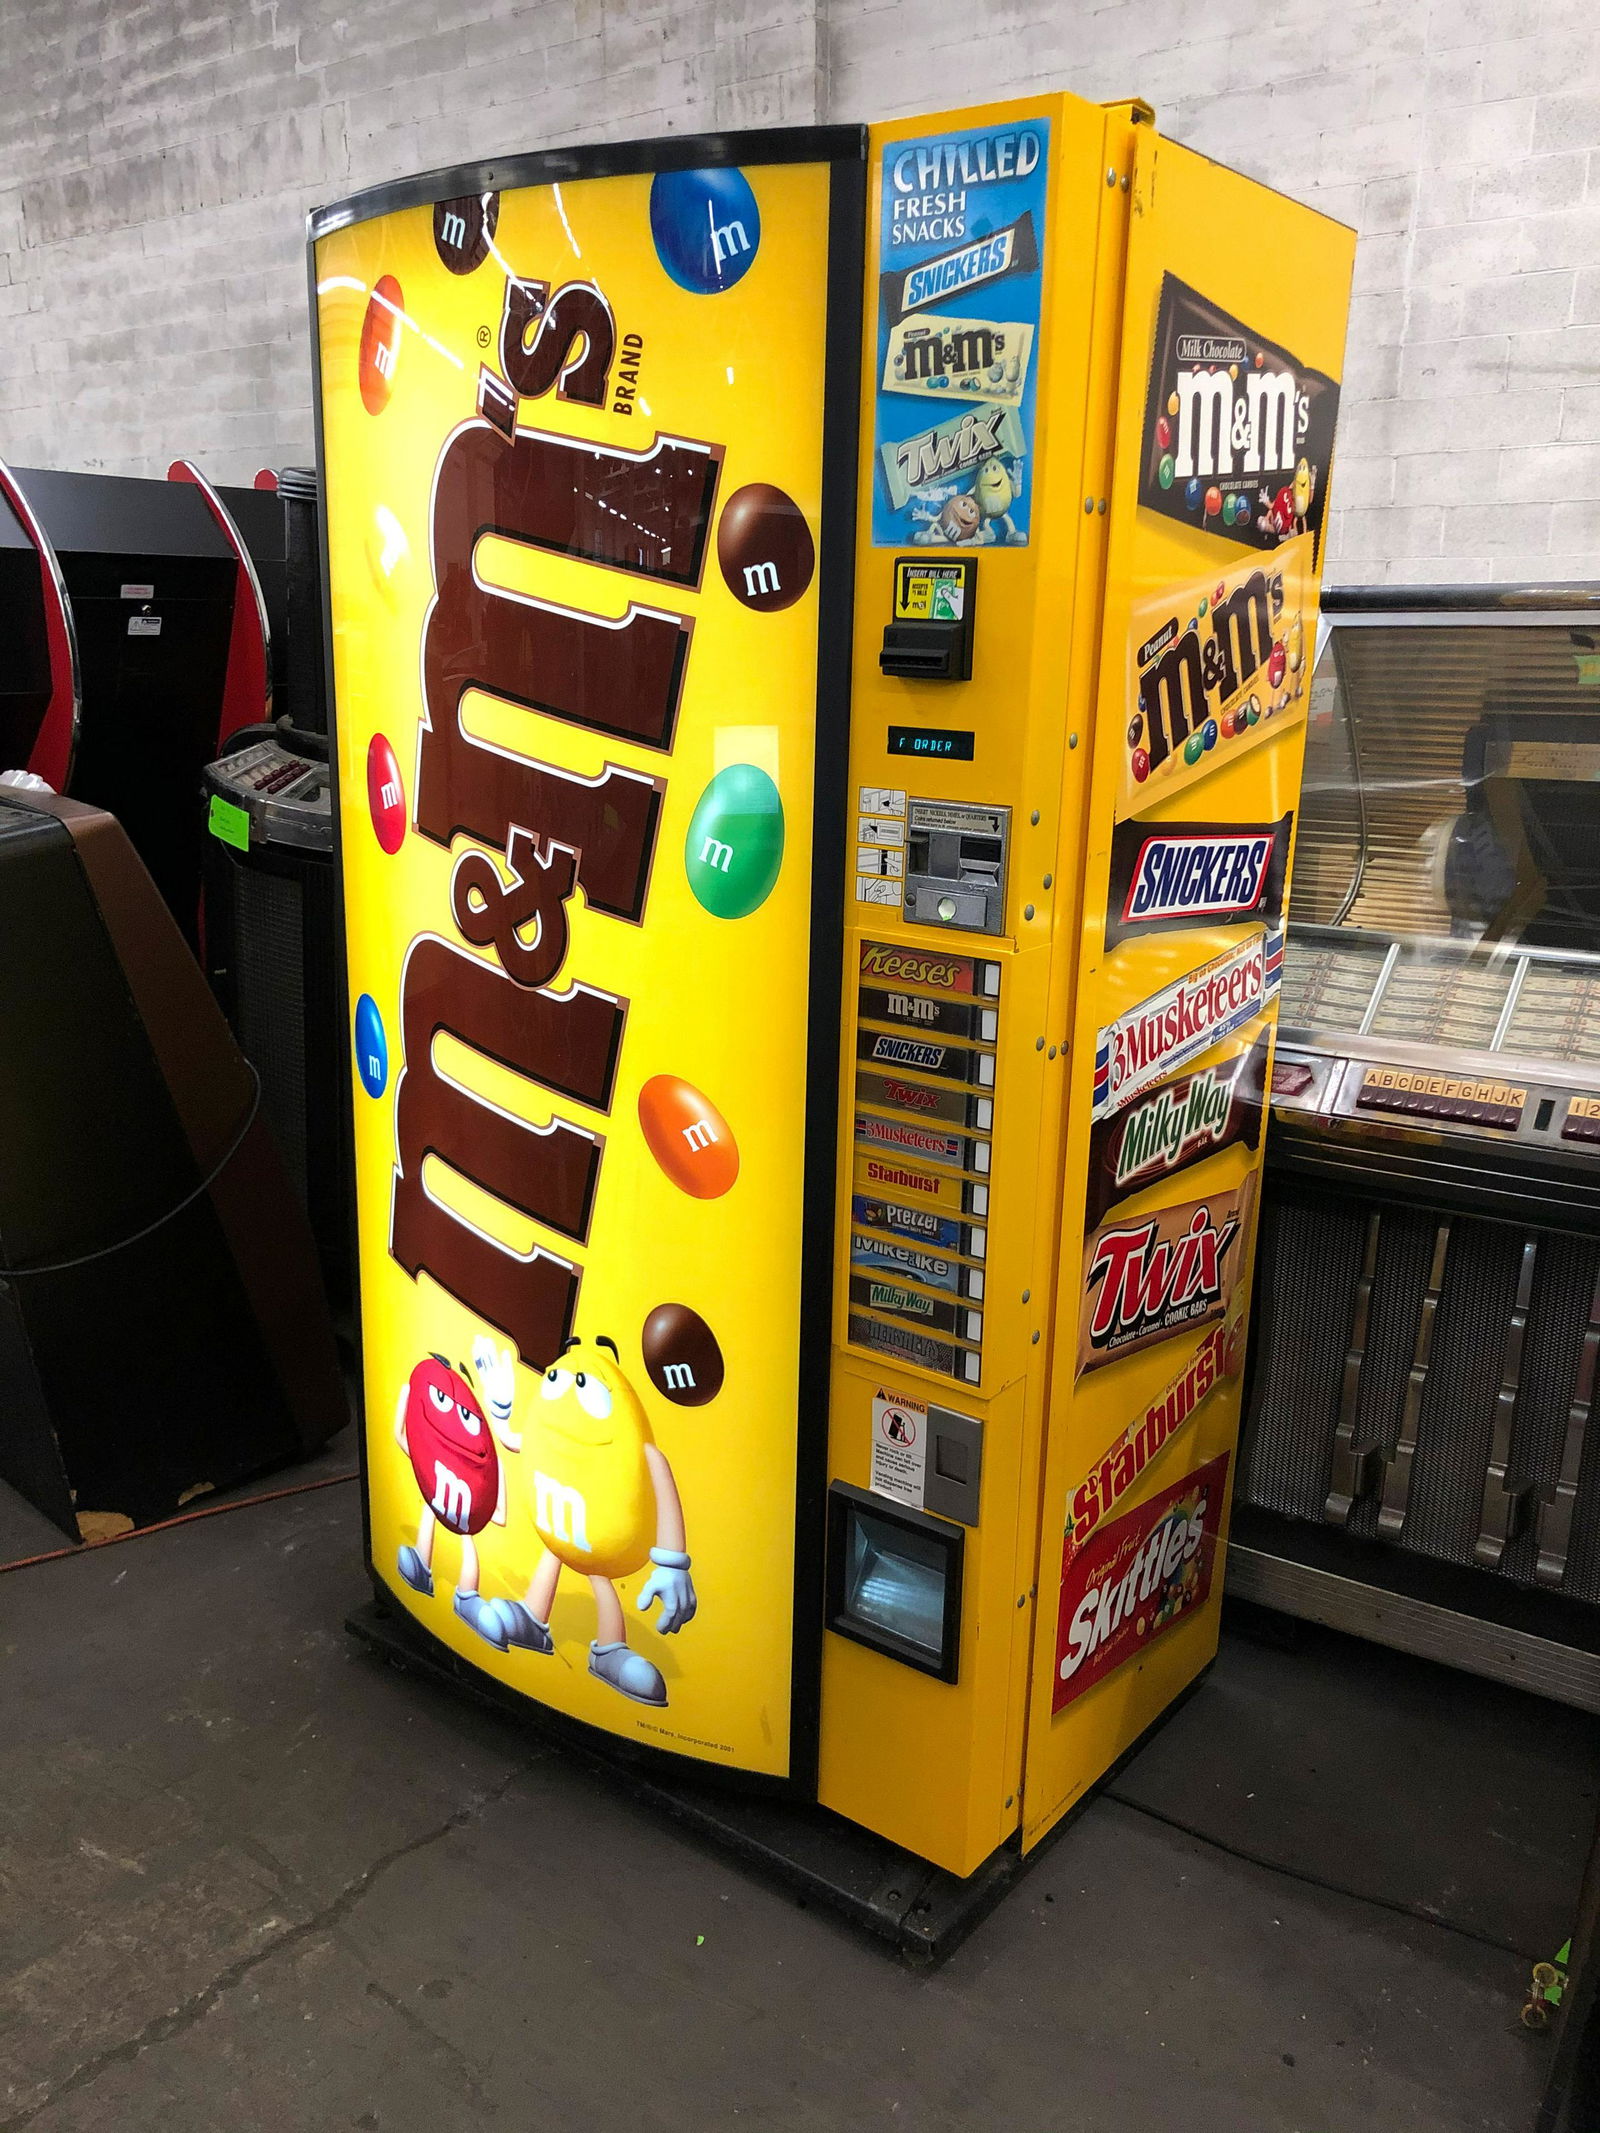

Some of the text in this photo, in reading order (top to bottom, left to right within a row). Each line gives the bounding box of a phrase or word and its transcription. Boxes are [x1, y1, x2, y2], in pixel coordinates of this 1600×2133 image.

[893, 130, 1040, 194] CHILLED
[893, 191, 967, 220] FRESH
[892, 216, 966, 245] SNACKS
[907, 233, 1009, 307] SNICKERS
[1180, 338, 1243, 360] Milk Chocolate
[612, 332, 645, 416] BRAND
[897, 408, 1004, 486] Twix
[1143, 622, 1173, 662] Peanut
[914, 738, 953, 752] ORDER
[1132, 840, 1267, 914] SNICKERS
[875, 1037, 943, 1067] SNICKERS
[883, 1079, 940, 1108] Twix
[1367, 1074, 1377, 1084] A
[1382, 1076, 1393, 1086] B
[1398, 1077, 1408, 1089] C
[1413, 1080, 1424, 1091] D
[1429, 1082, 1440, 1093] E
[1444, 1084, 1457, 1096] F
[1461, 1086, 1472, 1098] G
[1477, 1089, 1490, 1100] H
[1494, 1091, 1505, 1102] J
[1510, 1093, 1522, 1105] K
[1116, 1072, 1234, 1180] Milky Way
[867, 1162, 941, 1194] Starburst
[886, 1204, 939, 1232] Pretzel
[1088, 1204, 1240, 1338] Twix
[871, 1284, 932, 1315] Milky Way
[1164, 1306, 1189, 1327] COOKIE
[1189, 1298, 1208, 1316] BARS
[887, 1393, 926, 1414] WARNING
[1073, 1325, 1226, 1539] Starburst
[1085, 1544, 1121, 1591] Original
[1059, 1500, 1207, 1681] Skittles
